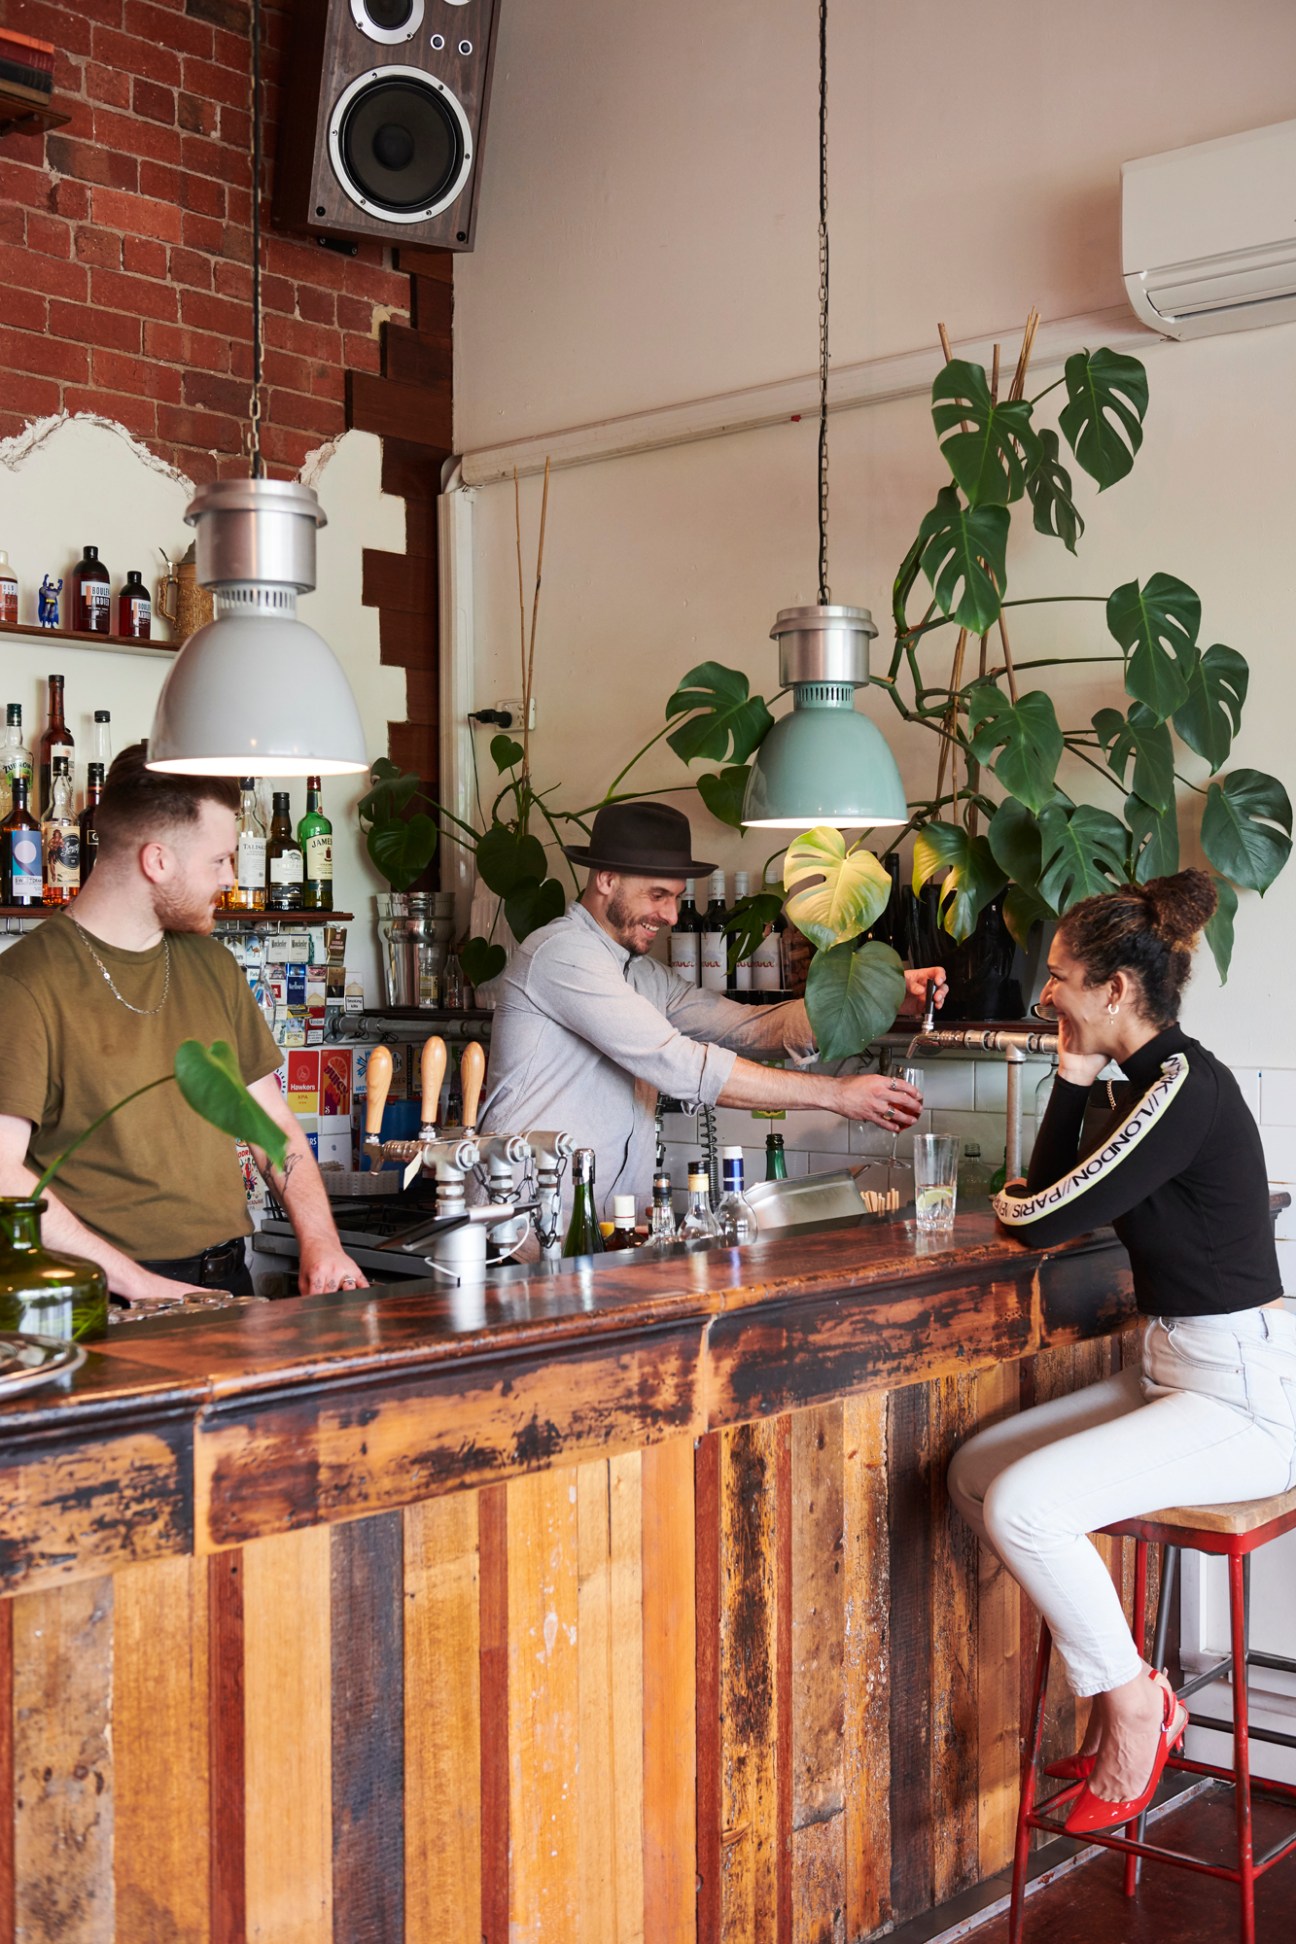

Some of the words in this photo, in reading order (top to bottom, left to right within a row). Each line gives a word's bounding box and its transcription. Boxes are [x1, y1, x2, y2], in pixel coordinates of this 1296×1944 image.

[311, 837, 332, 849] JAME
[290, 1083, 316, 1091] Hawkers
[1072, 1107, 1153, 1186] LONDON
[1012, 1187, 1062, 1218] PARIS
